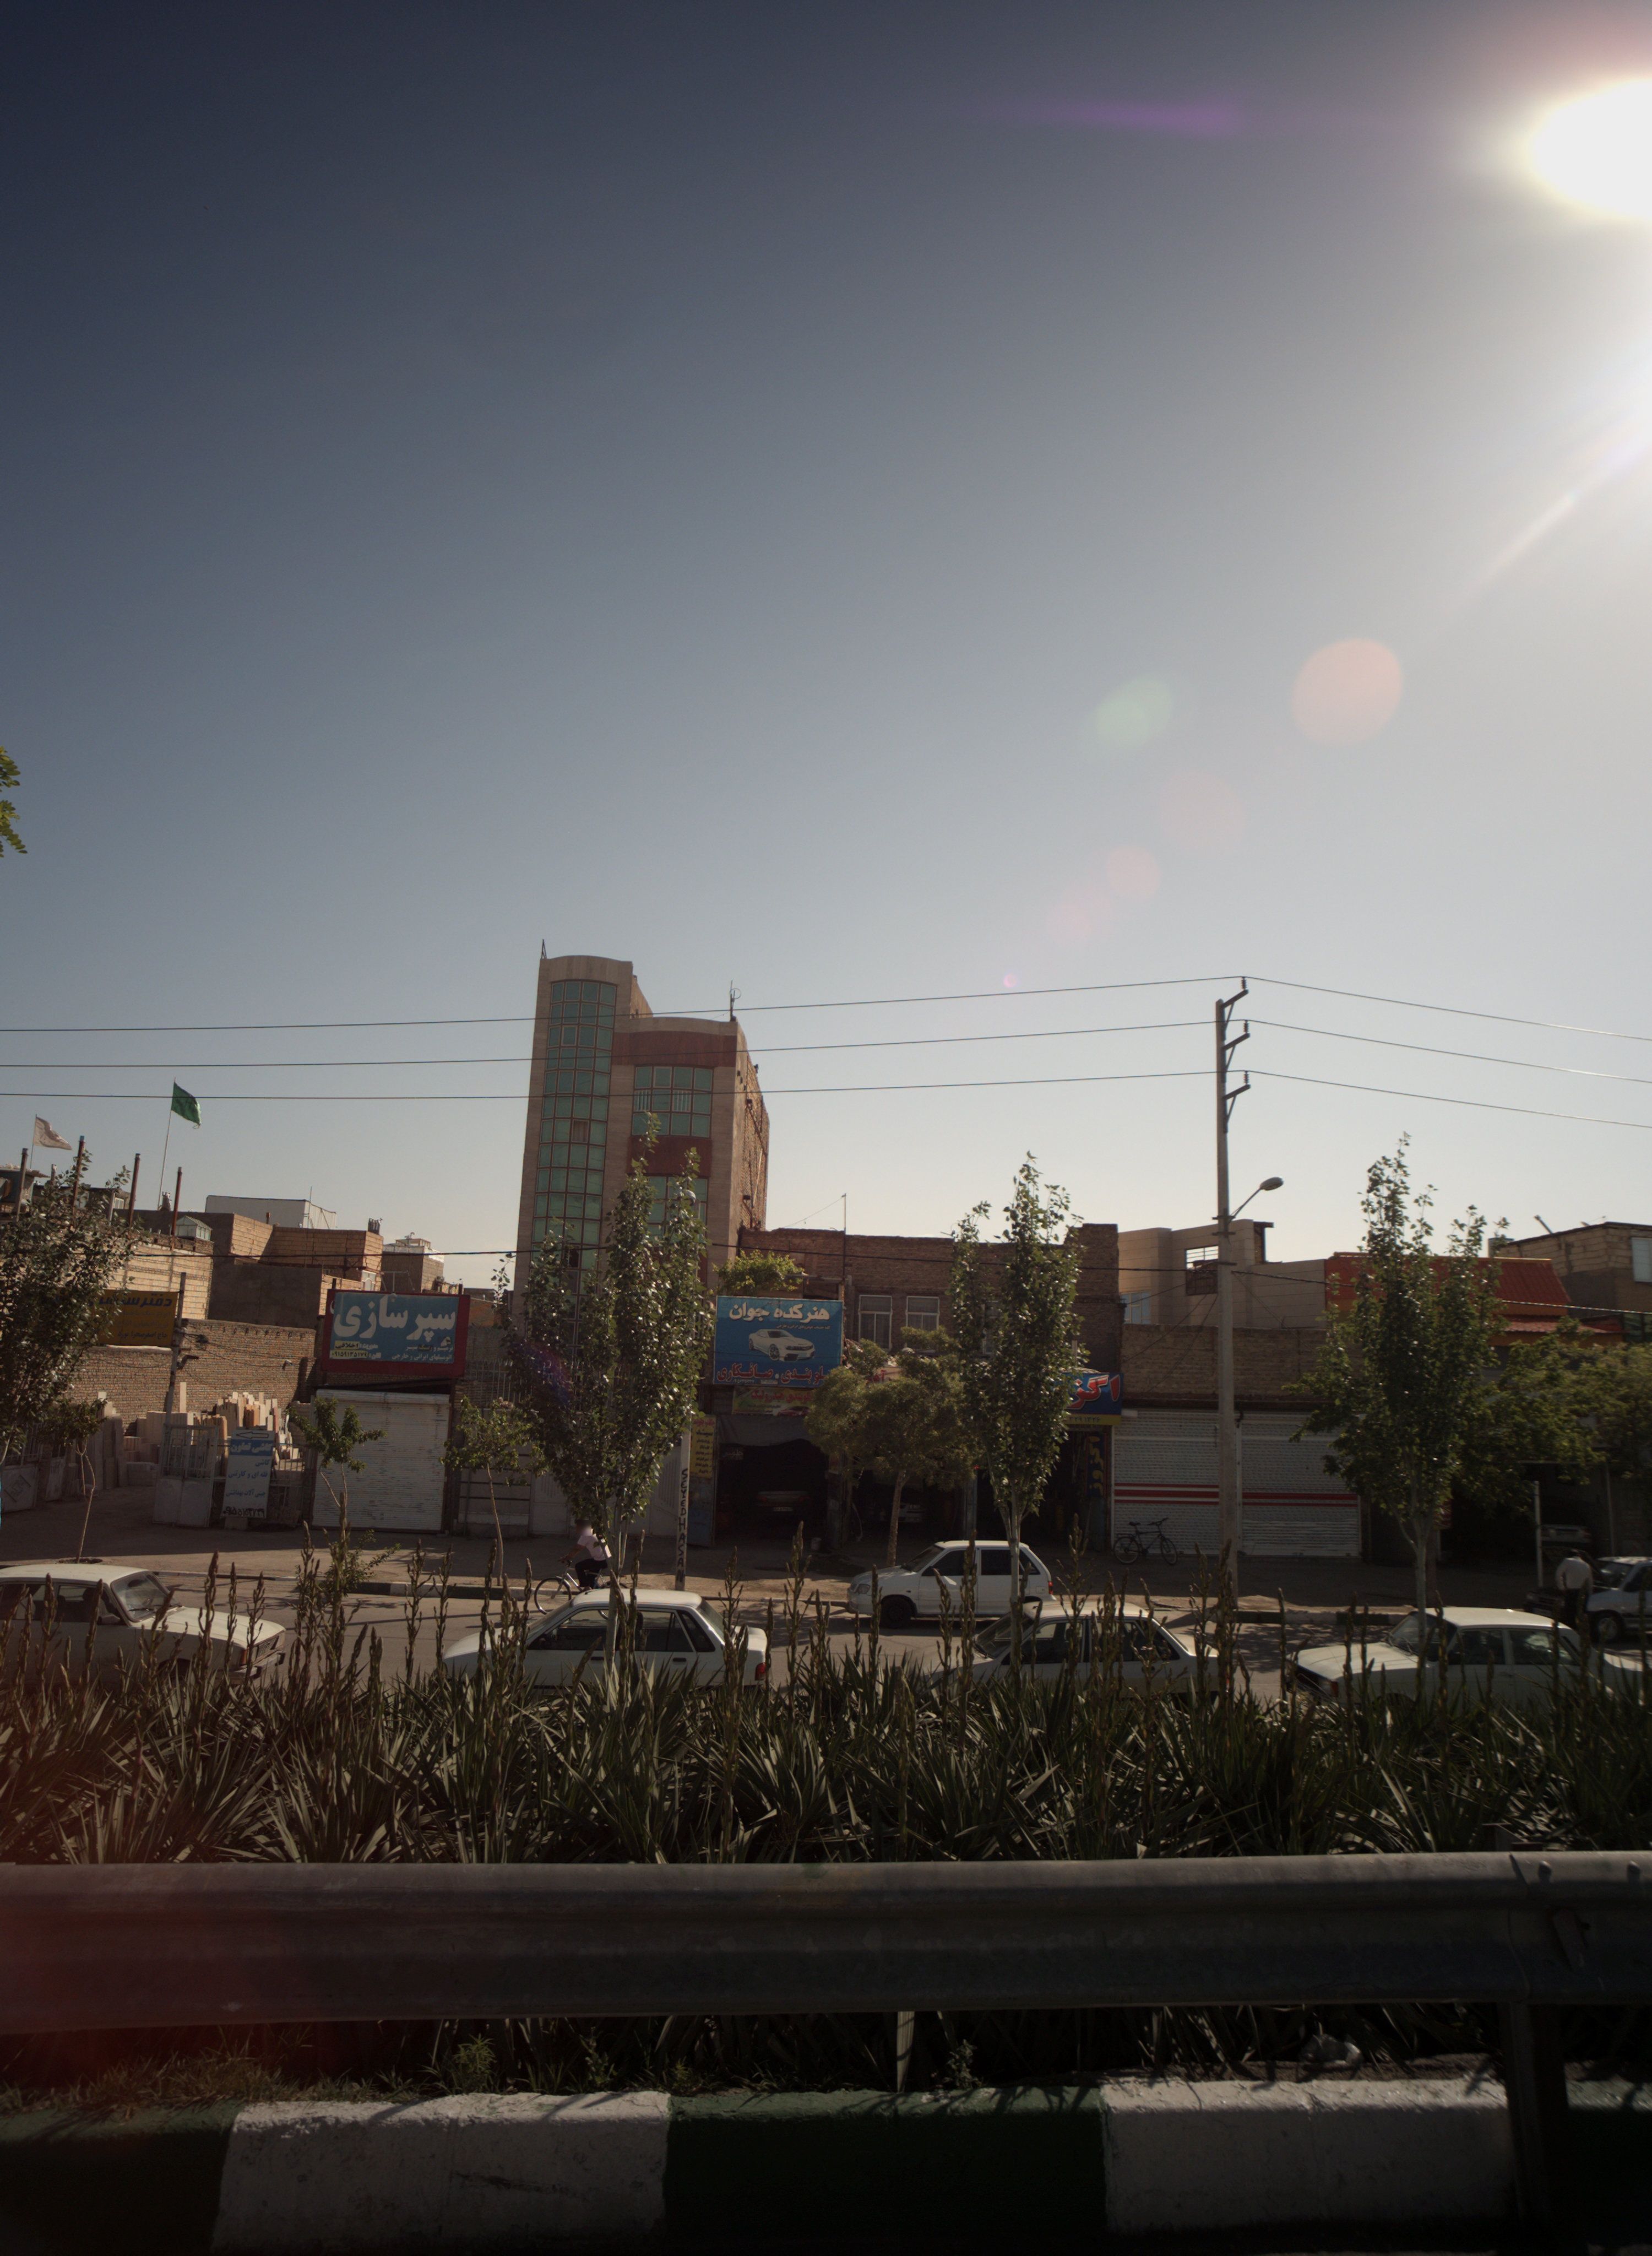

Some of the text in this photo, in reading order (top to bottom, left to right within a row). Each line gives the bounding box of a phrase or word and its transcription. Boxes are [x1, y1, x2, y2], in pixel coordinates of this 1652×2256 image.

[140, 1293, 172, 1307] دفتر
[334, 1294, 456, 1342] سپر سازی
[729, 1302, 769, 1321] جوان
[717, 1362, 774, 1382] صافکاری
[676, 1516, 686, 1582] HASAN
